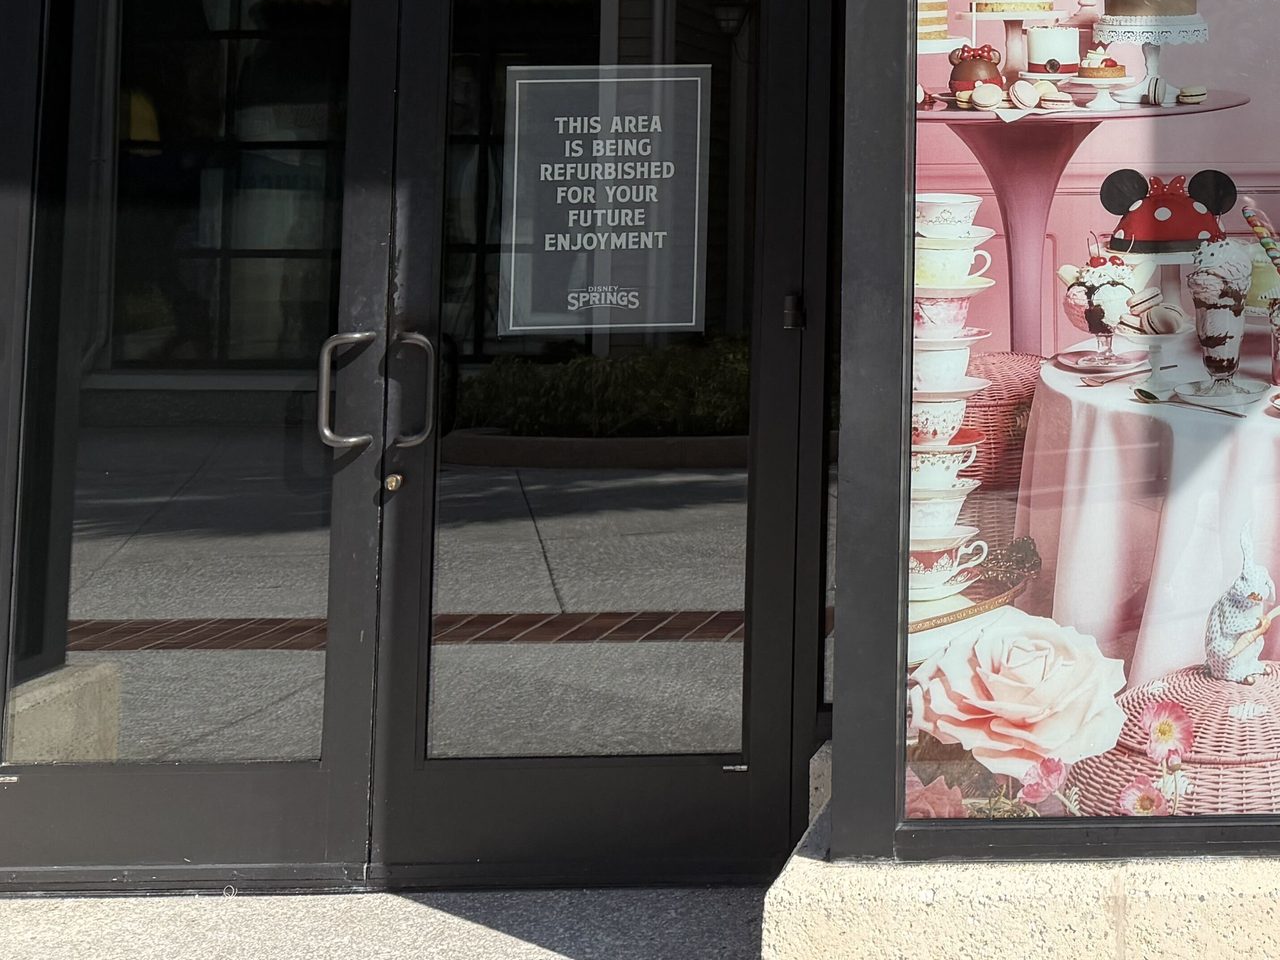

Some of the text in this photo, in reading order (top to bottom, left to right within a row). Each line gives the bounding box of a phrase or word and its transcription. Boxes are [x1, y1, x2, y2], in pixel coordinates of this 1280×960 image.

[554, 115, 662, 134] THIS AREA
[564, 139, 651, 157] IS BEING
[540, 161, 675, 181] REFURBISHED
[556, 185, 658, 204] FOR YOUR
[568, 209, 645, 227] FUTURE
[544, 232, 667, 251] ENJOYMENT
[567, 291, 639, 310] SPRINGS
